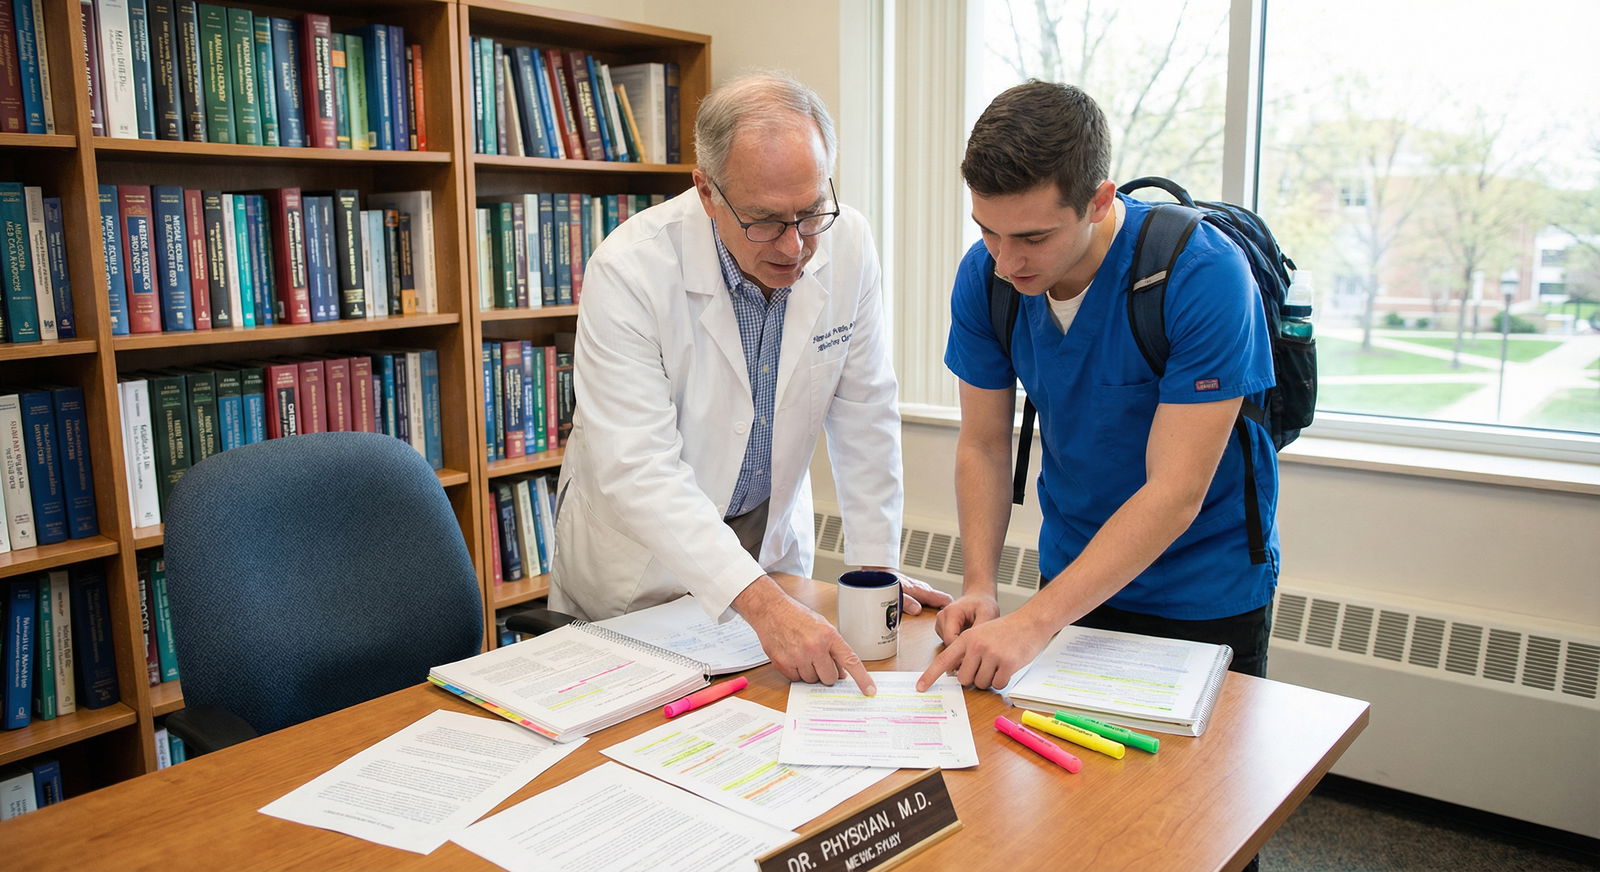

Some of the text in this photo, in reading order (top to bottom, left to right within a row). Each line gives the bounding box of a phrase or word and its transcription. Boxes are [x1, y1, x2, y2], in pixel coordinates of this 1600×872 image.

[786, 791, 932, 872] DR. PHYSCIAN, M.D.
